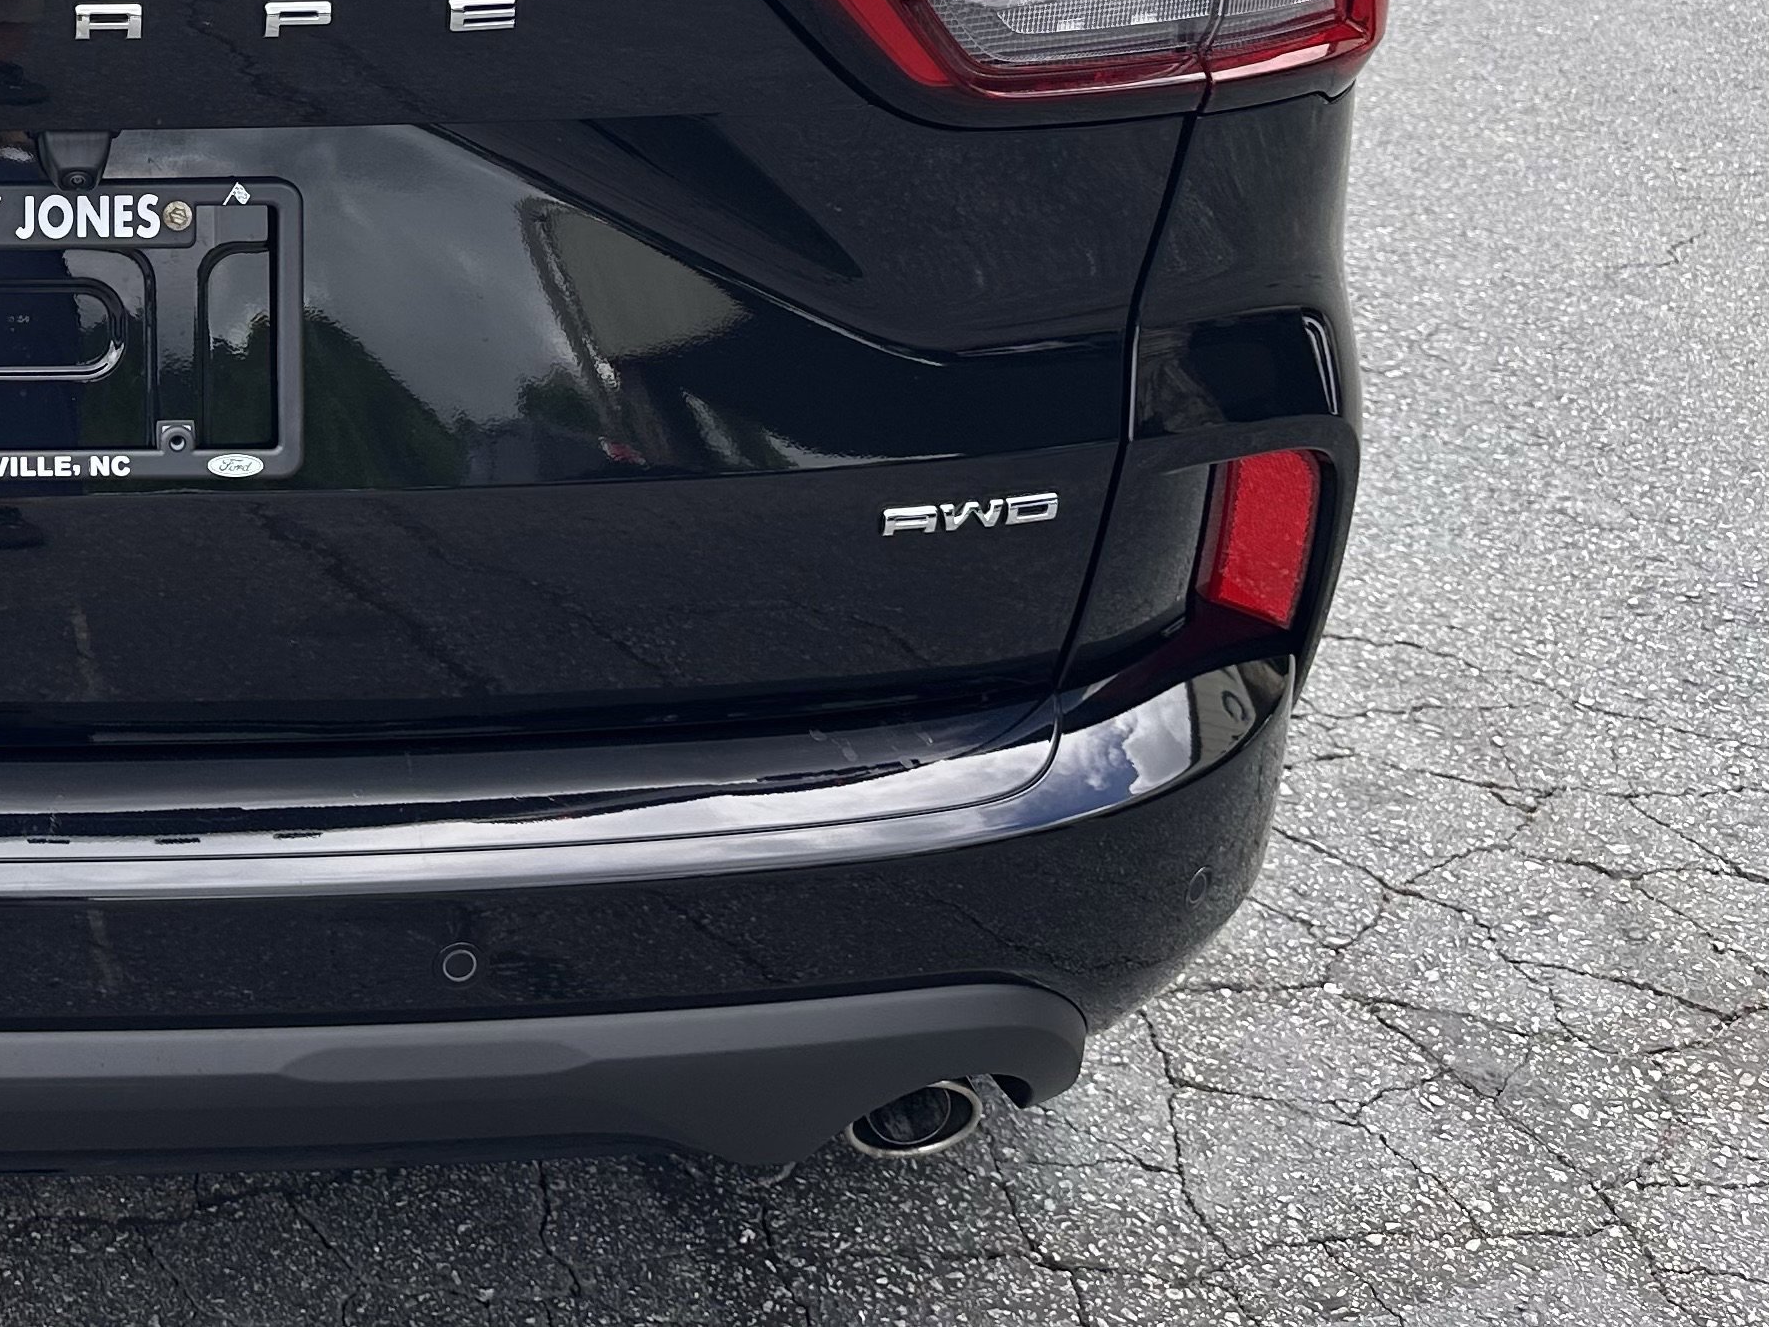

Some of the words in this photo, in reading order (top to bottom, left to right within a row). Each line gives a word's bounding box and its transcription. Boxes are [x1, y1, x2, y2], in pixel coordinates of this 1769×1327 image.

[15, 193, 161, 240] JONES
[90, 455, 131, 477] NC
[219, 458, 253, 472] Ford
[882, 492, 1059, 537] AWD
